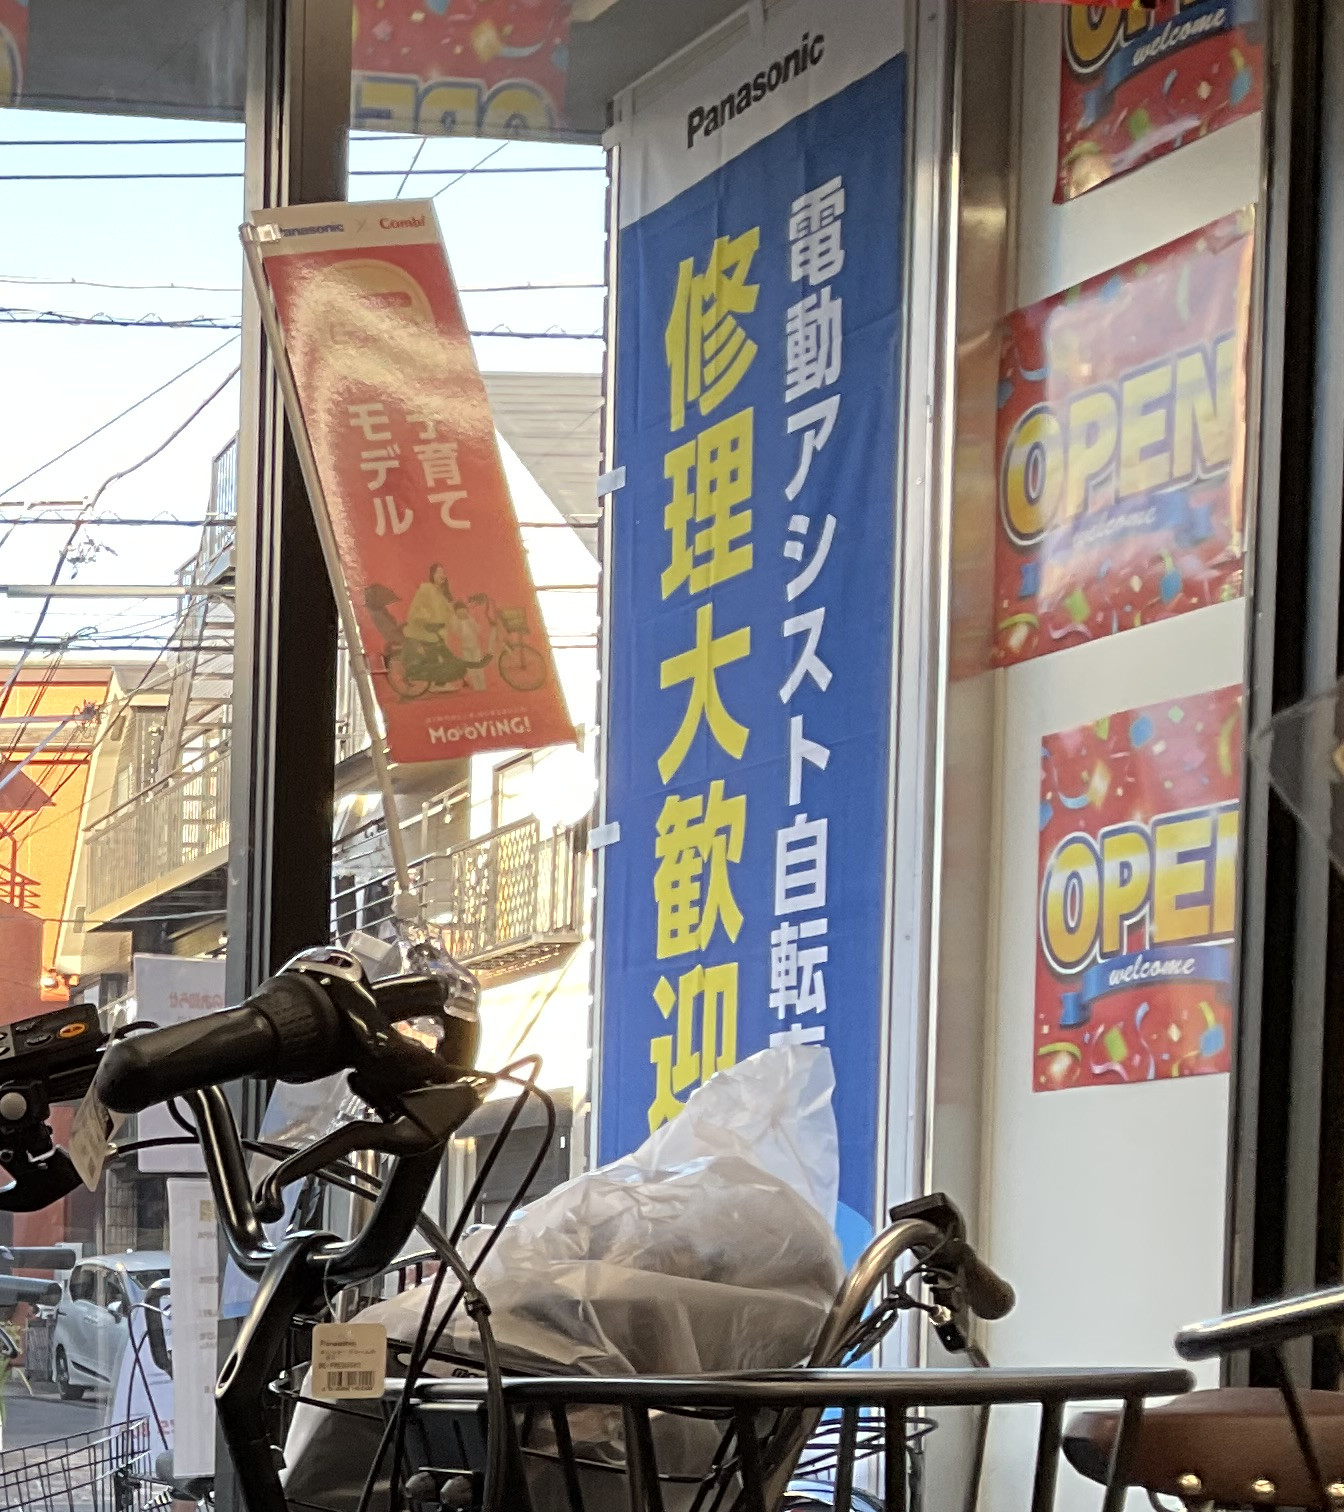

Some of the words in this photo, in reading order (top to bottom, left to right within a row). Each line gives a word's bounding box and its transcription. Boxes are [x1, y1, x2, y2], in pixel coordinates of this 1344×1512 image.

[686, 32, 825, 149] Panasonic
[1131, 7, 1226, 66] welcome
[280, 223, 345, 238] anasonic
[380, 215, 426, 230] Combi
[347, 402, 414, 538] モデル
[406, 406, 472, 532] 子育て
[1000, 333, 1238, 546] OPEN
[769, 175, 847, 1049] 電動アシスト自転
[648, 226, 761, 1137] 修理大歓迎
[1109, 956, 1196, 988] welcome
